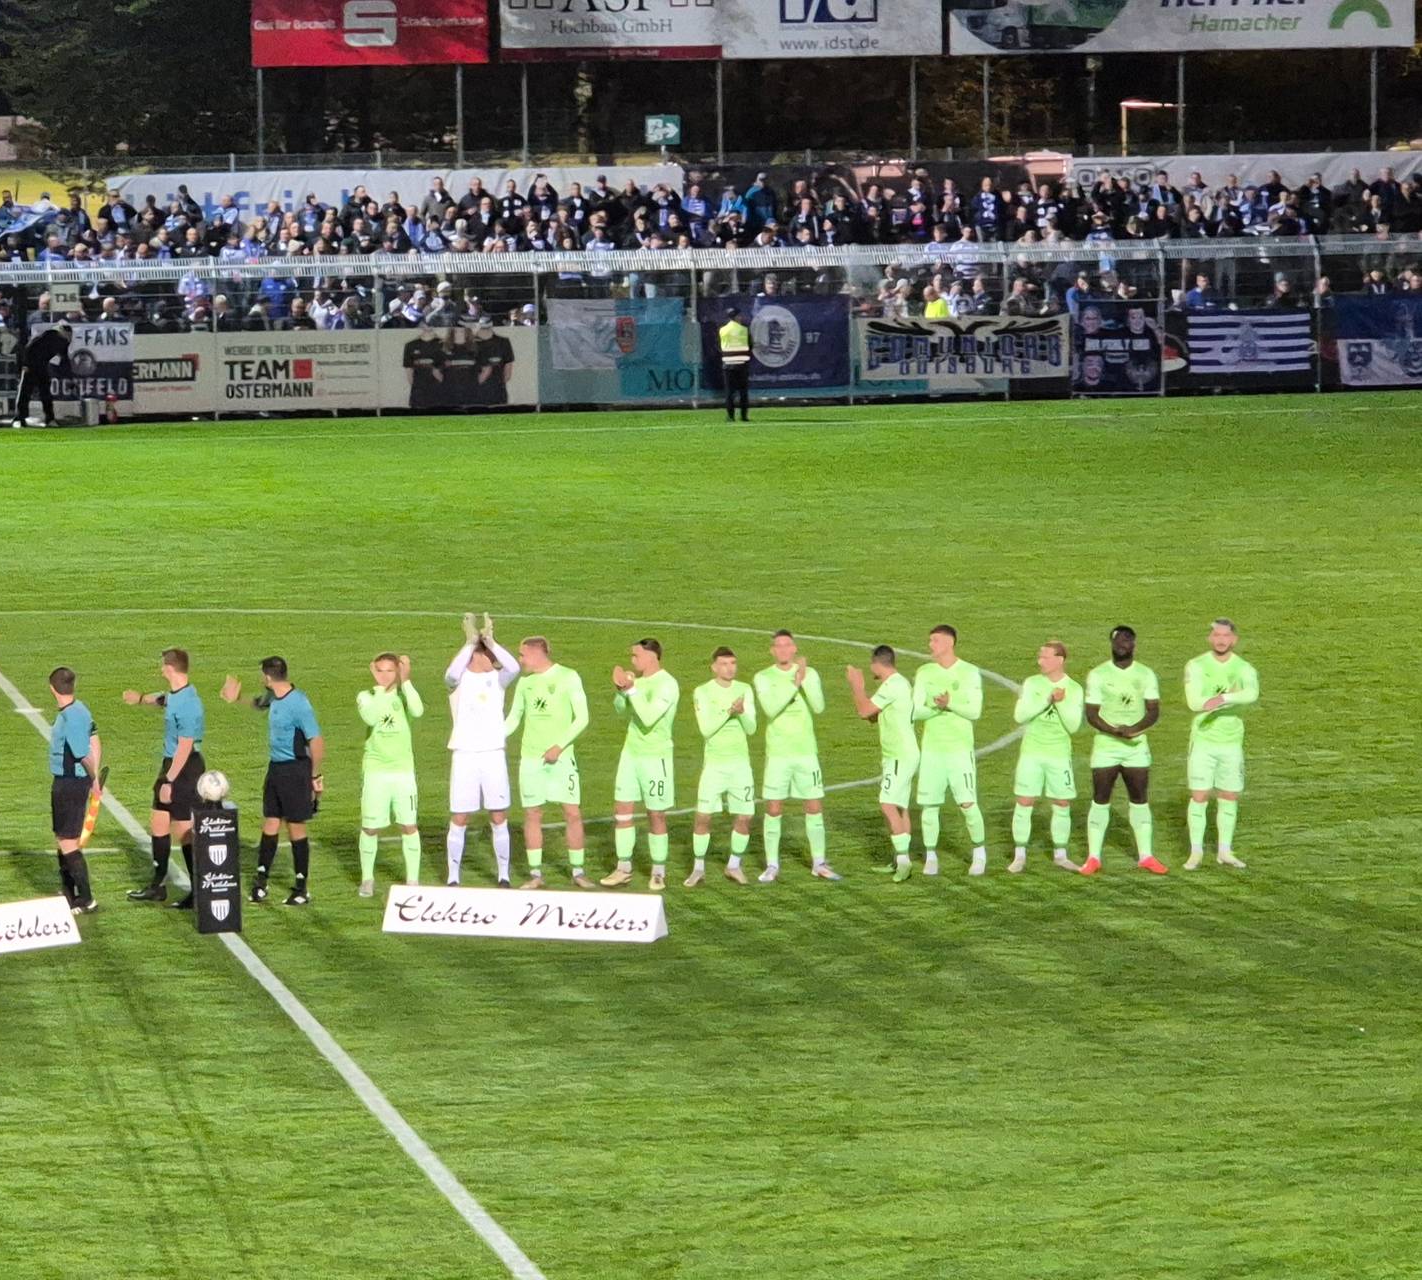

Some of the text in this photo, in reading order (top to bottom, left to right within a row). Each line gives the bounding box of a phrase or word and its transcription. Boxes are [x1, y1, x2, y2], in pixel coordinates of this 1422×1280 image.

[550, 19, 673, 34] Hochbau GmbH
[1190, 13, 1302, 32] Hamacher
[779, 36, 879, 50] www.idst.de
[76, 329, 129, 346] -FANS
[133, 361, 193, 379] ERMANN
[224, 360, 289, 380] TEAM
[226, 382, 313, 399] OSTERMANN
[569, 774, 575, 791] 5
[1064, 770, 1071, 786] 3
[649, 780, 664, 797] 28
[384, 895, 649, 931] Elektro Mölders
